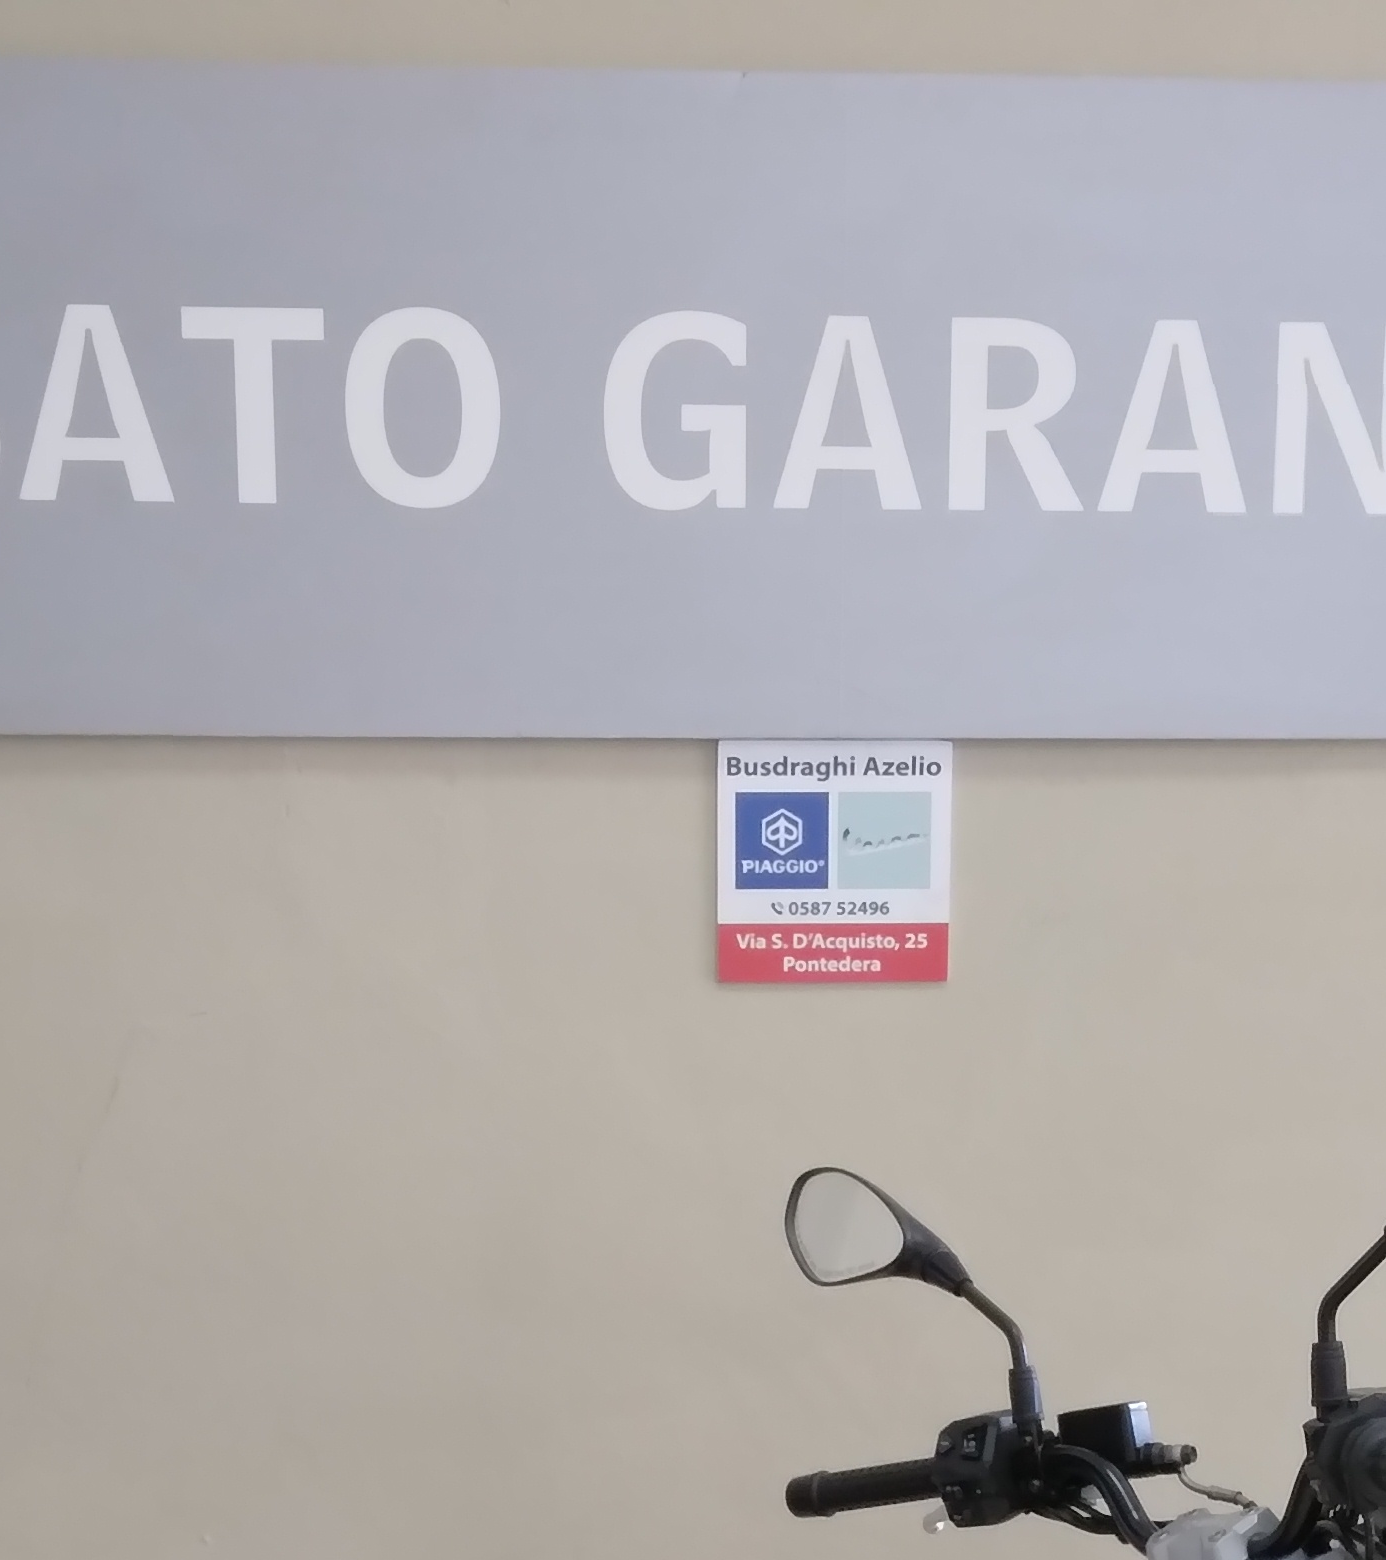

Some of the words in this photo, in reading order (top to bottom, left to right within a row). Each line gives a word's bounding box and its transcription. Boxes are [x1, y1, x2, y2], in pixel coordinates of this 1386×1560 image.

[726, 756, 856, 781] Busdraghi
[863, 756, 942, 777] Azelio
[741, 859, 819, 874] PIAGGIO
[788, 902, 831, 916] 0587
[836, 902, 890, 916] 52496
[736, 933, 766, 950] Via
[771, 933, 788, 950] S.
[793, 933, 900, 953] D'Acquisto,
[905, 933, 928, 949] 25
[783, 956, 881, 973] Pontedera
